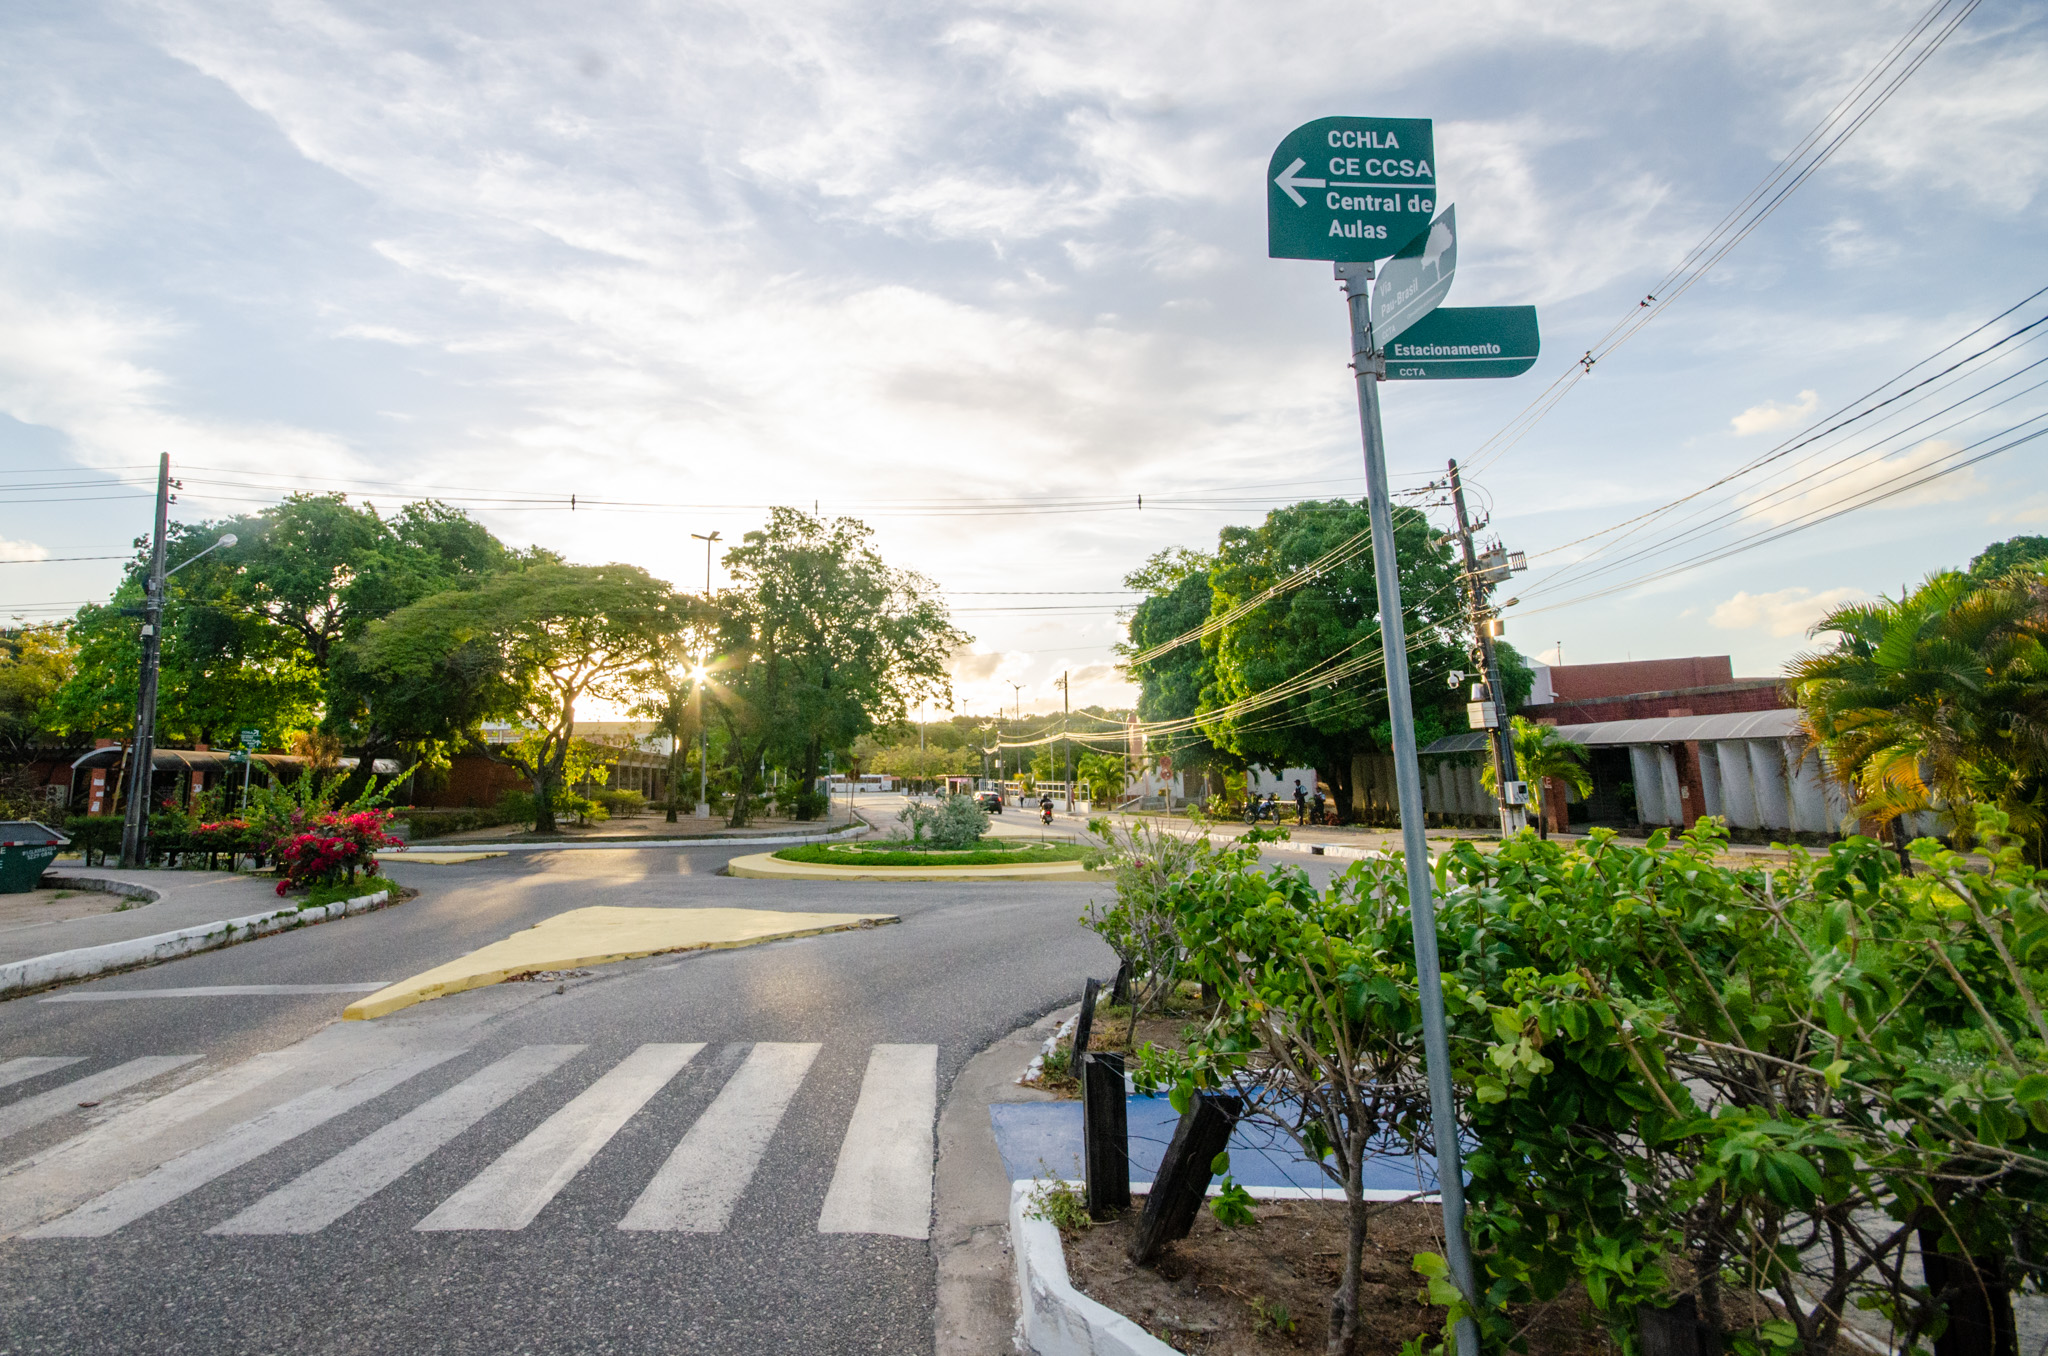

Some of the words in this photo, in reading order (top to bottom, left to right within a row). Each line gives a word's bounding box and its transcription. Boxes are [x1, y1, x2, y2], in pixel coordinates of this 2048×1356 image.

[1328, 130, 1399, 149] CCHLA
[1329, 157, 1361, 176] CE
[1365, 159, 1433, 178] CCSA
[1326, 191, 1401, 212] Central
[1408, 194, 1433, 213] de
[1328, 219, 1388, 239] Aulas
[1381, 277, 1418, 317] Pau-Brasil
[1394, 343, 1501, 356] Estacionamento
[1399, 367, 1426, 377] CCTA
